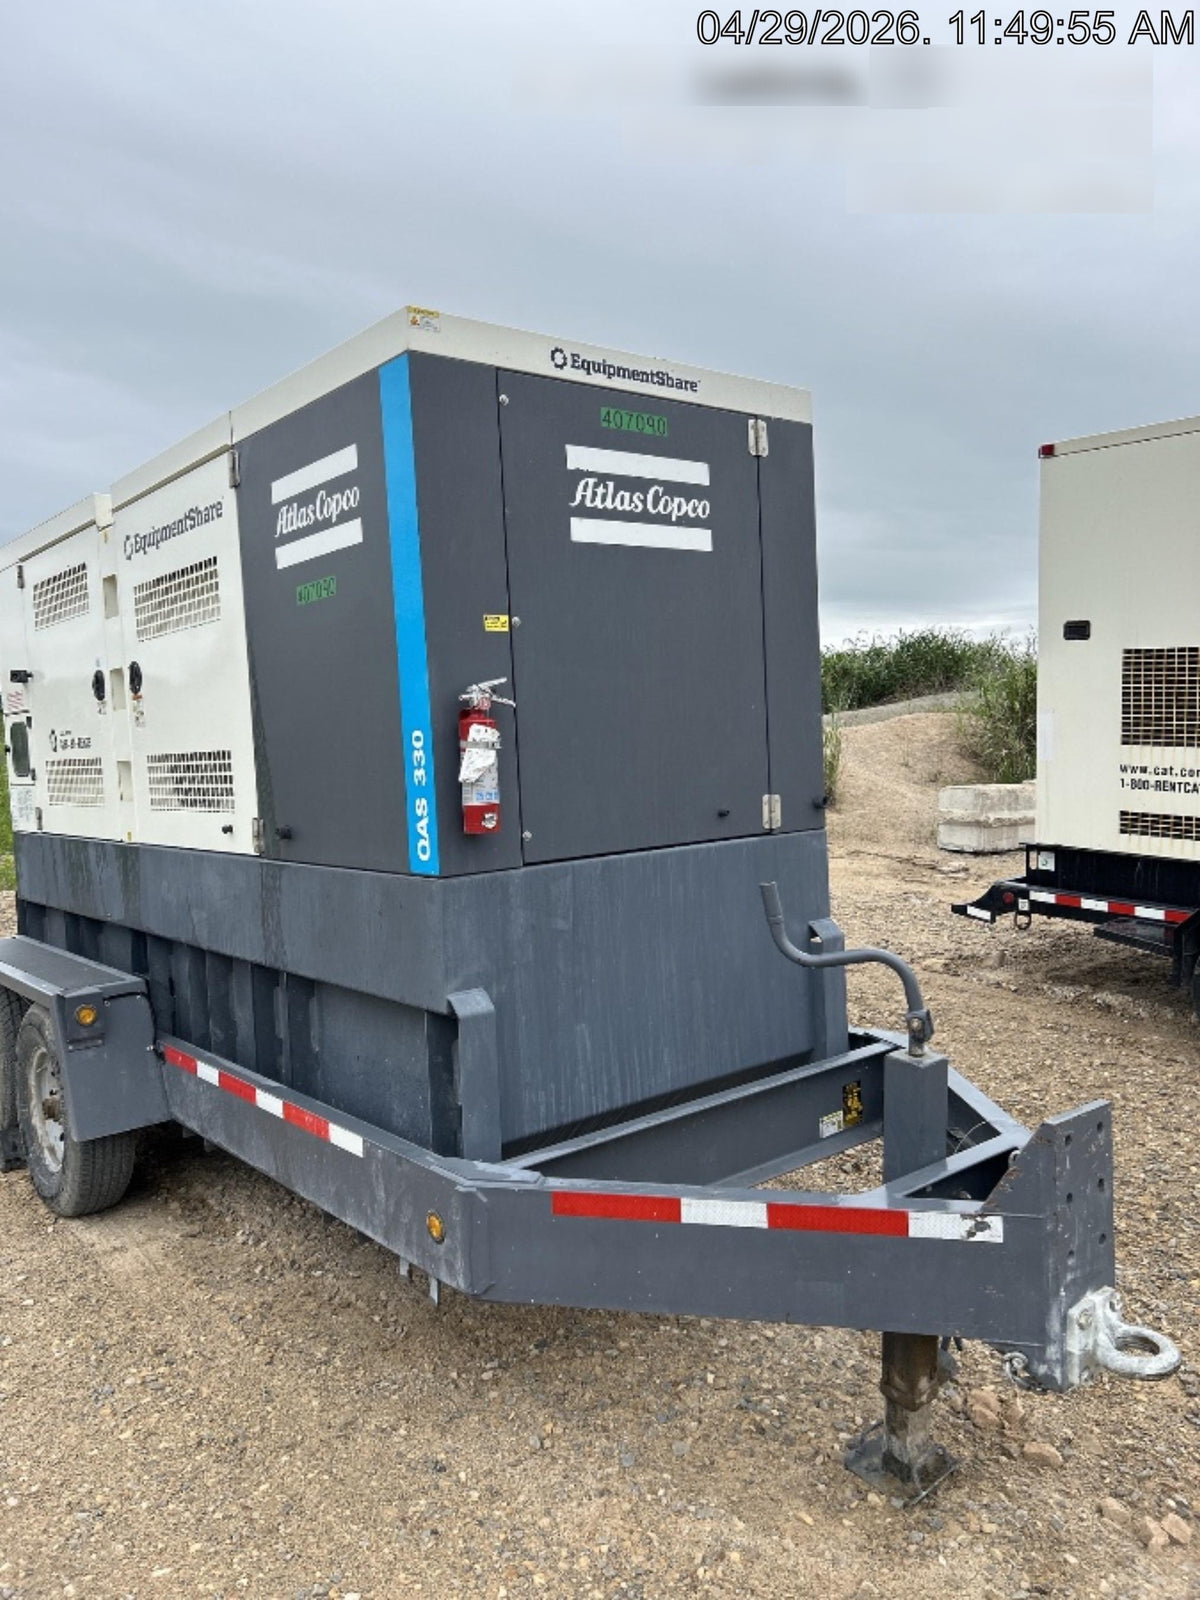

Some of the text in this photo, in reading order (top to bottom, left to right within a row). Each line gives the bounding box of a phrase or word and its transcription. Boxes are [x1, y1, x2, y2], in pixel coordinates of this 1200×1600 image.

[570, 352, 699, 393] EquipmentShare
[601, 408, 668, 437] 407090
[274, 486, 360, 538] Atlas Copco
[569, 476, 711, 521] Atlas Copco
[133, 499, 223, 555] EquipmentShare
[412, 730, 432, 862] QAS 330
[1120, 778, 1200, 794] 1-800-RENTCA
